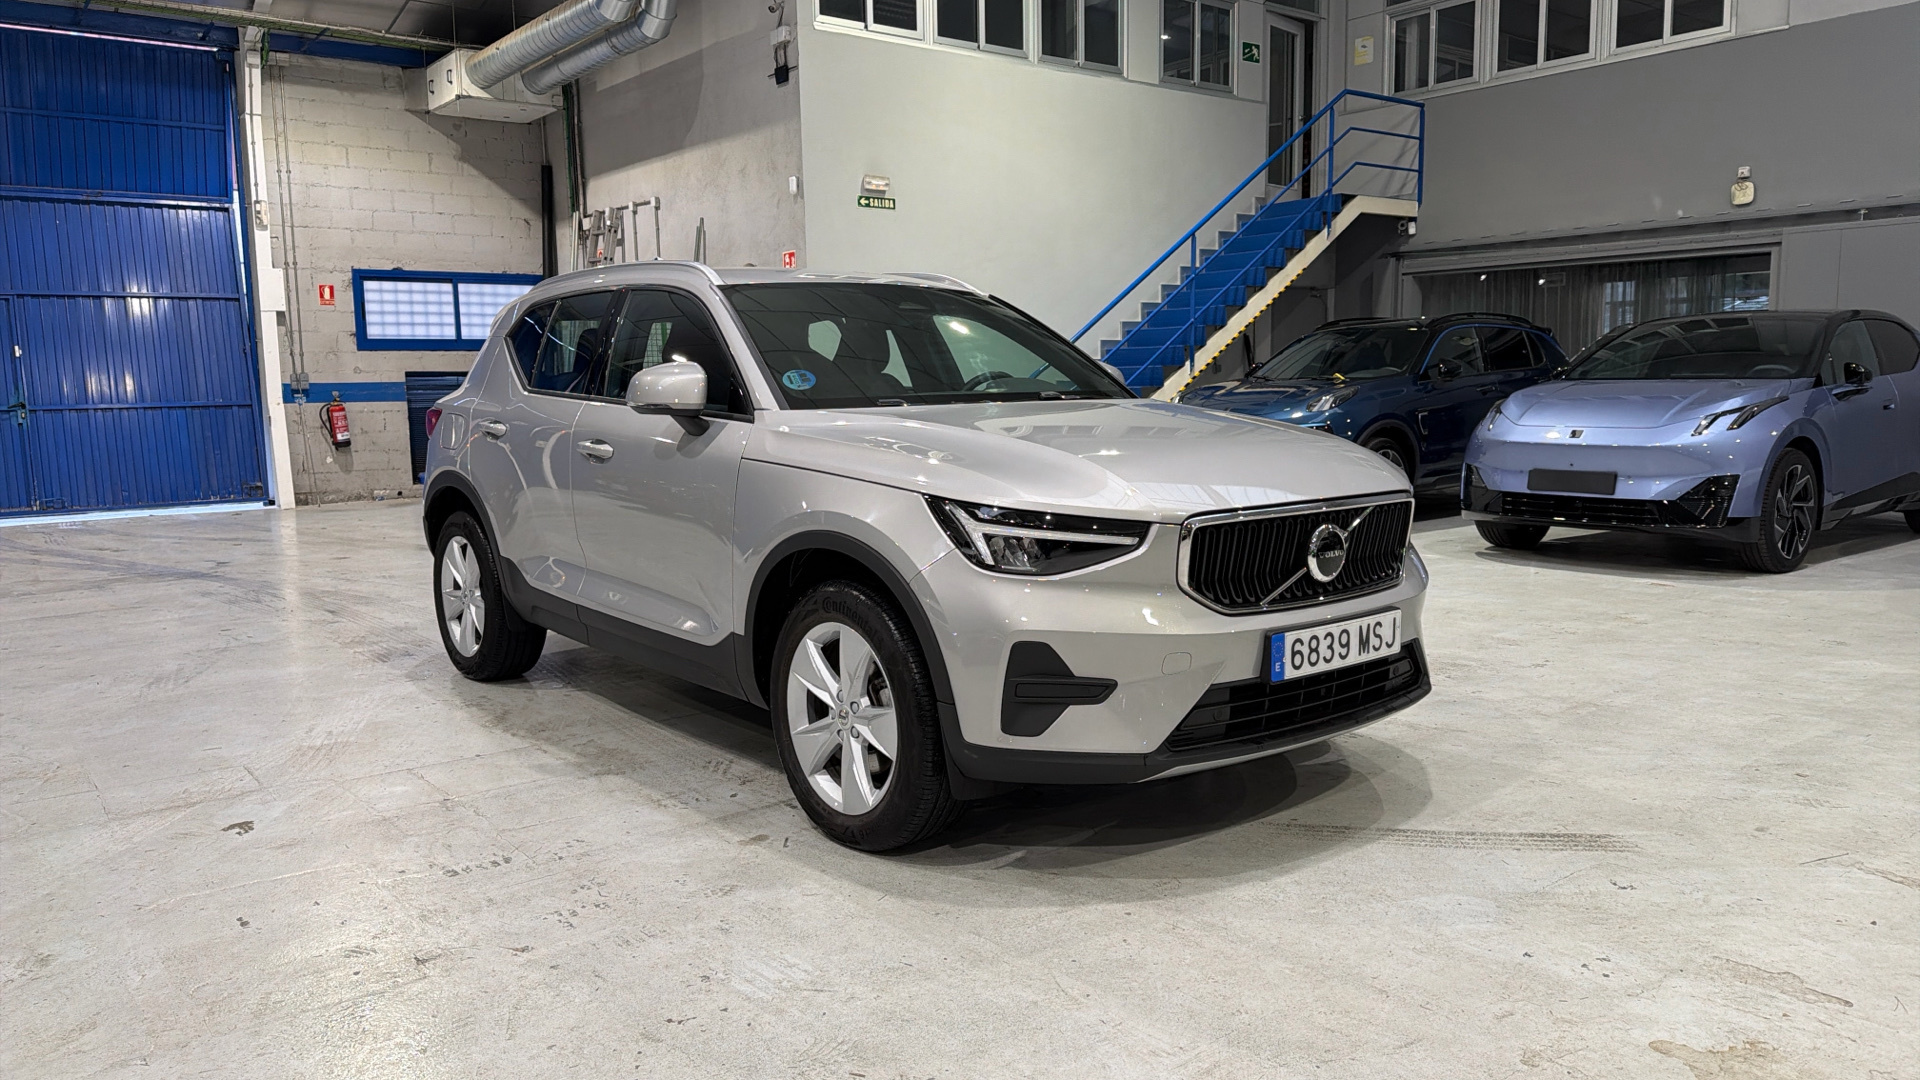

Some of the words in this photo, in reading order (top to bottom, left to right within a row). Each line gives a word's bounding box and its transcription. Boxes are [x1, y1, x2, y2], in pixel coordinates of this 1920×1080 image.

[869, 198, 895, 208] SALIDA
[1318, 550, 1344, 558] VOLVO
[1290, 628, 1350, 671] 6839
[1358, 617, 1397, 656] MSJ
[1275, 662, 1281, 672] E
